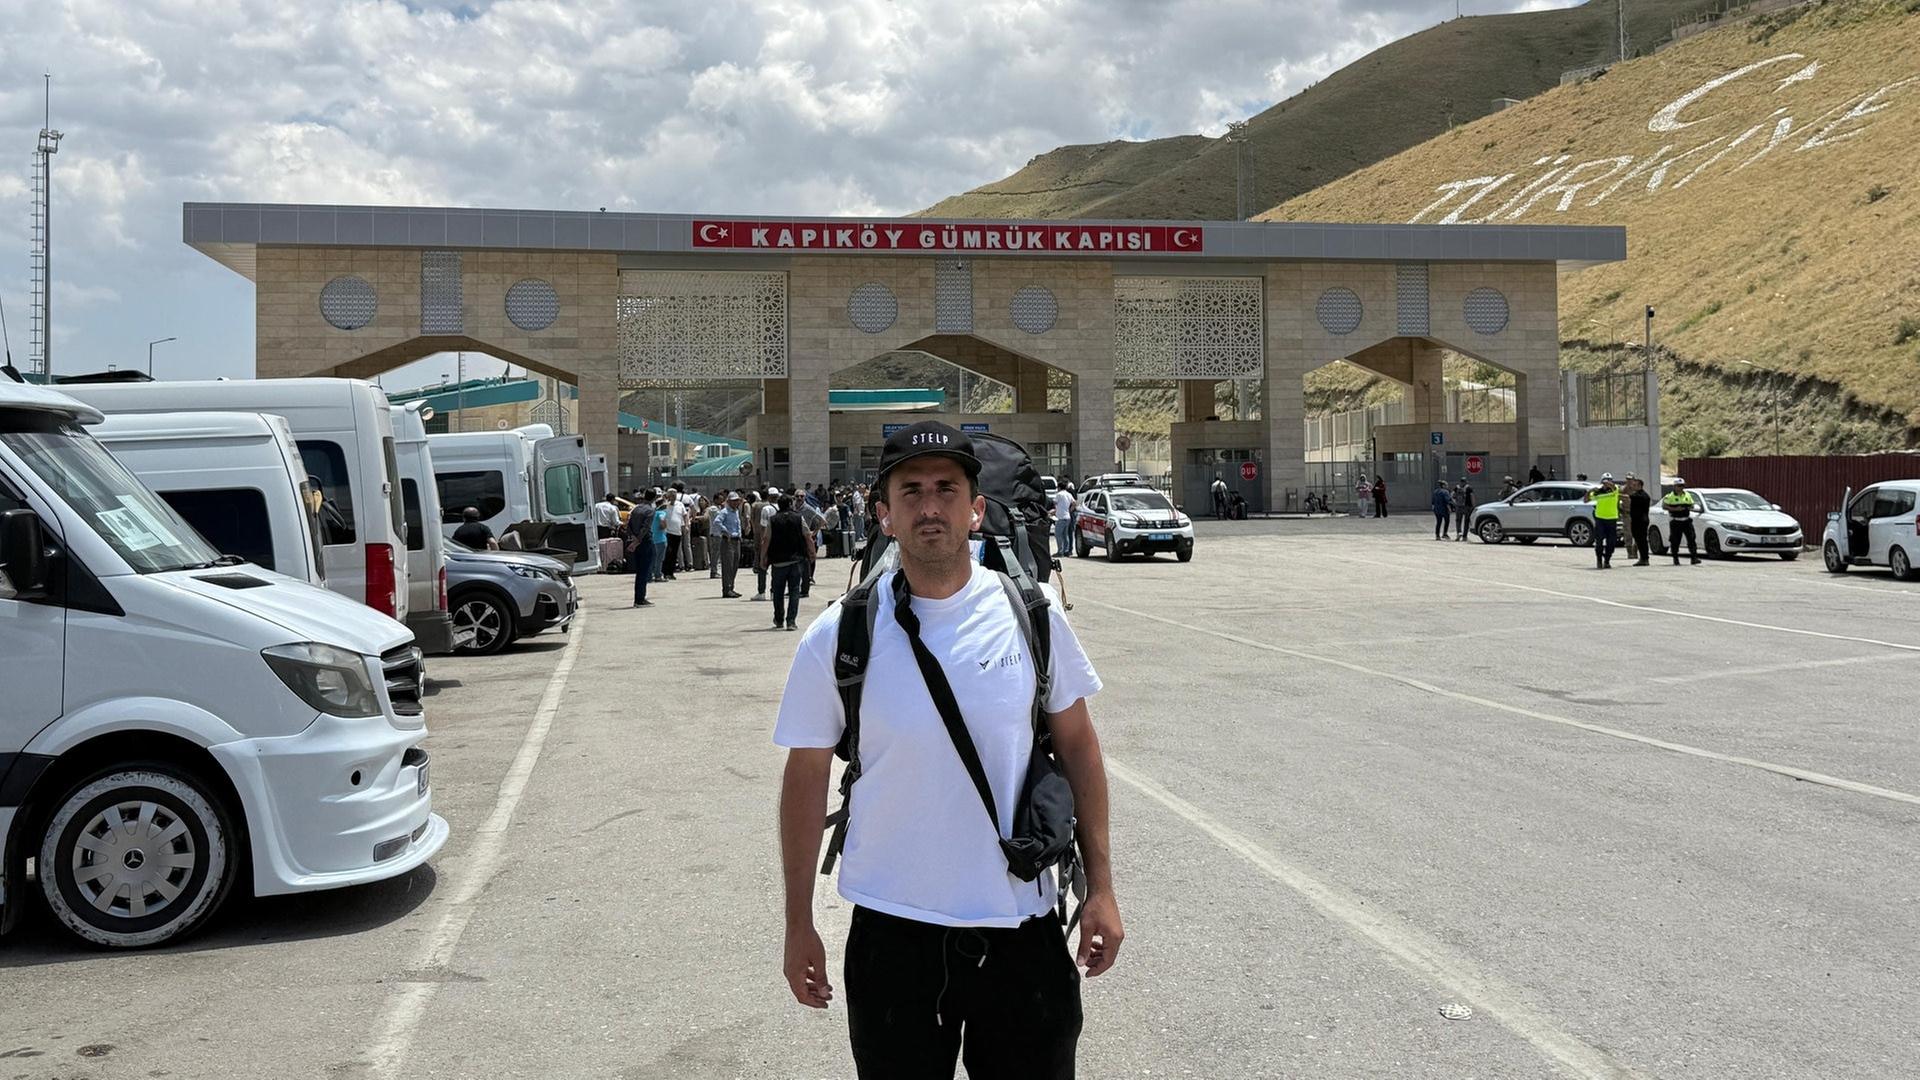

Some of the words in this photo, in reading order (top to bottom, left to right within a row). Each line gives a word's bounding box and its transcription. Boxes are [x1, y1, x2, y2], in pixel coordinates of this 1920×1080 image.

[751, 224, 903, 248] KAPIKÖY
[919, 224, 1044, 249] GÜMRÜK
[1055, 231, 1151, 250] KAPISI
[912, 432, 948, 445] STELP
[1466, 461, 1482, 469] DUR
[1240, 467, 1256, 475] DUR
